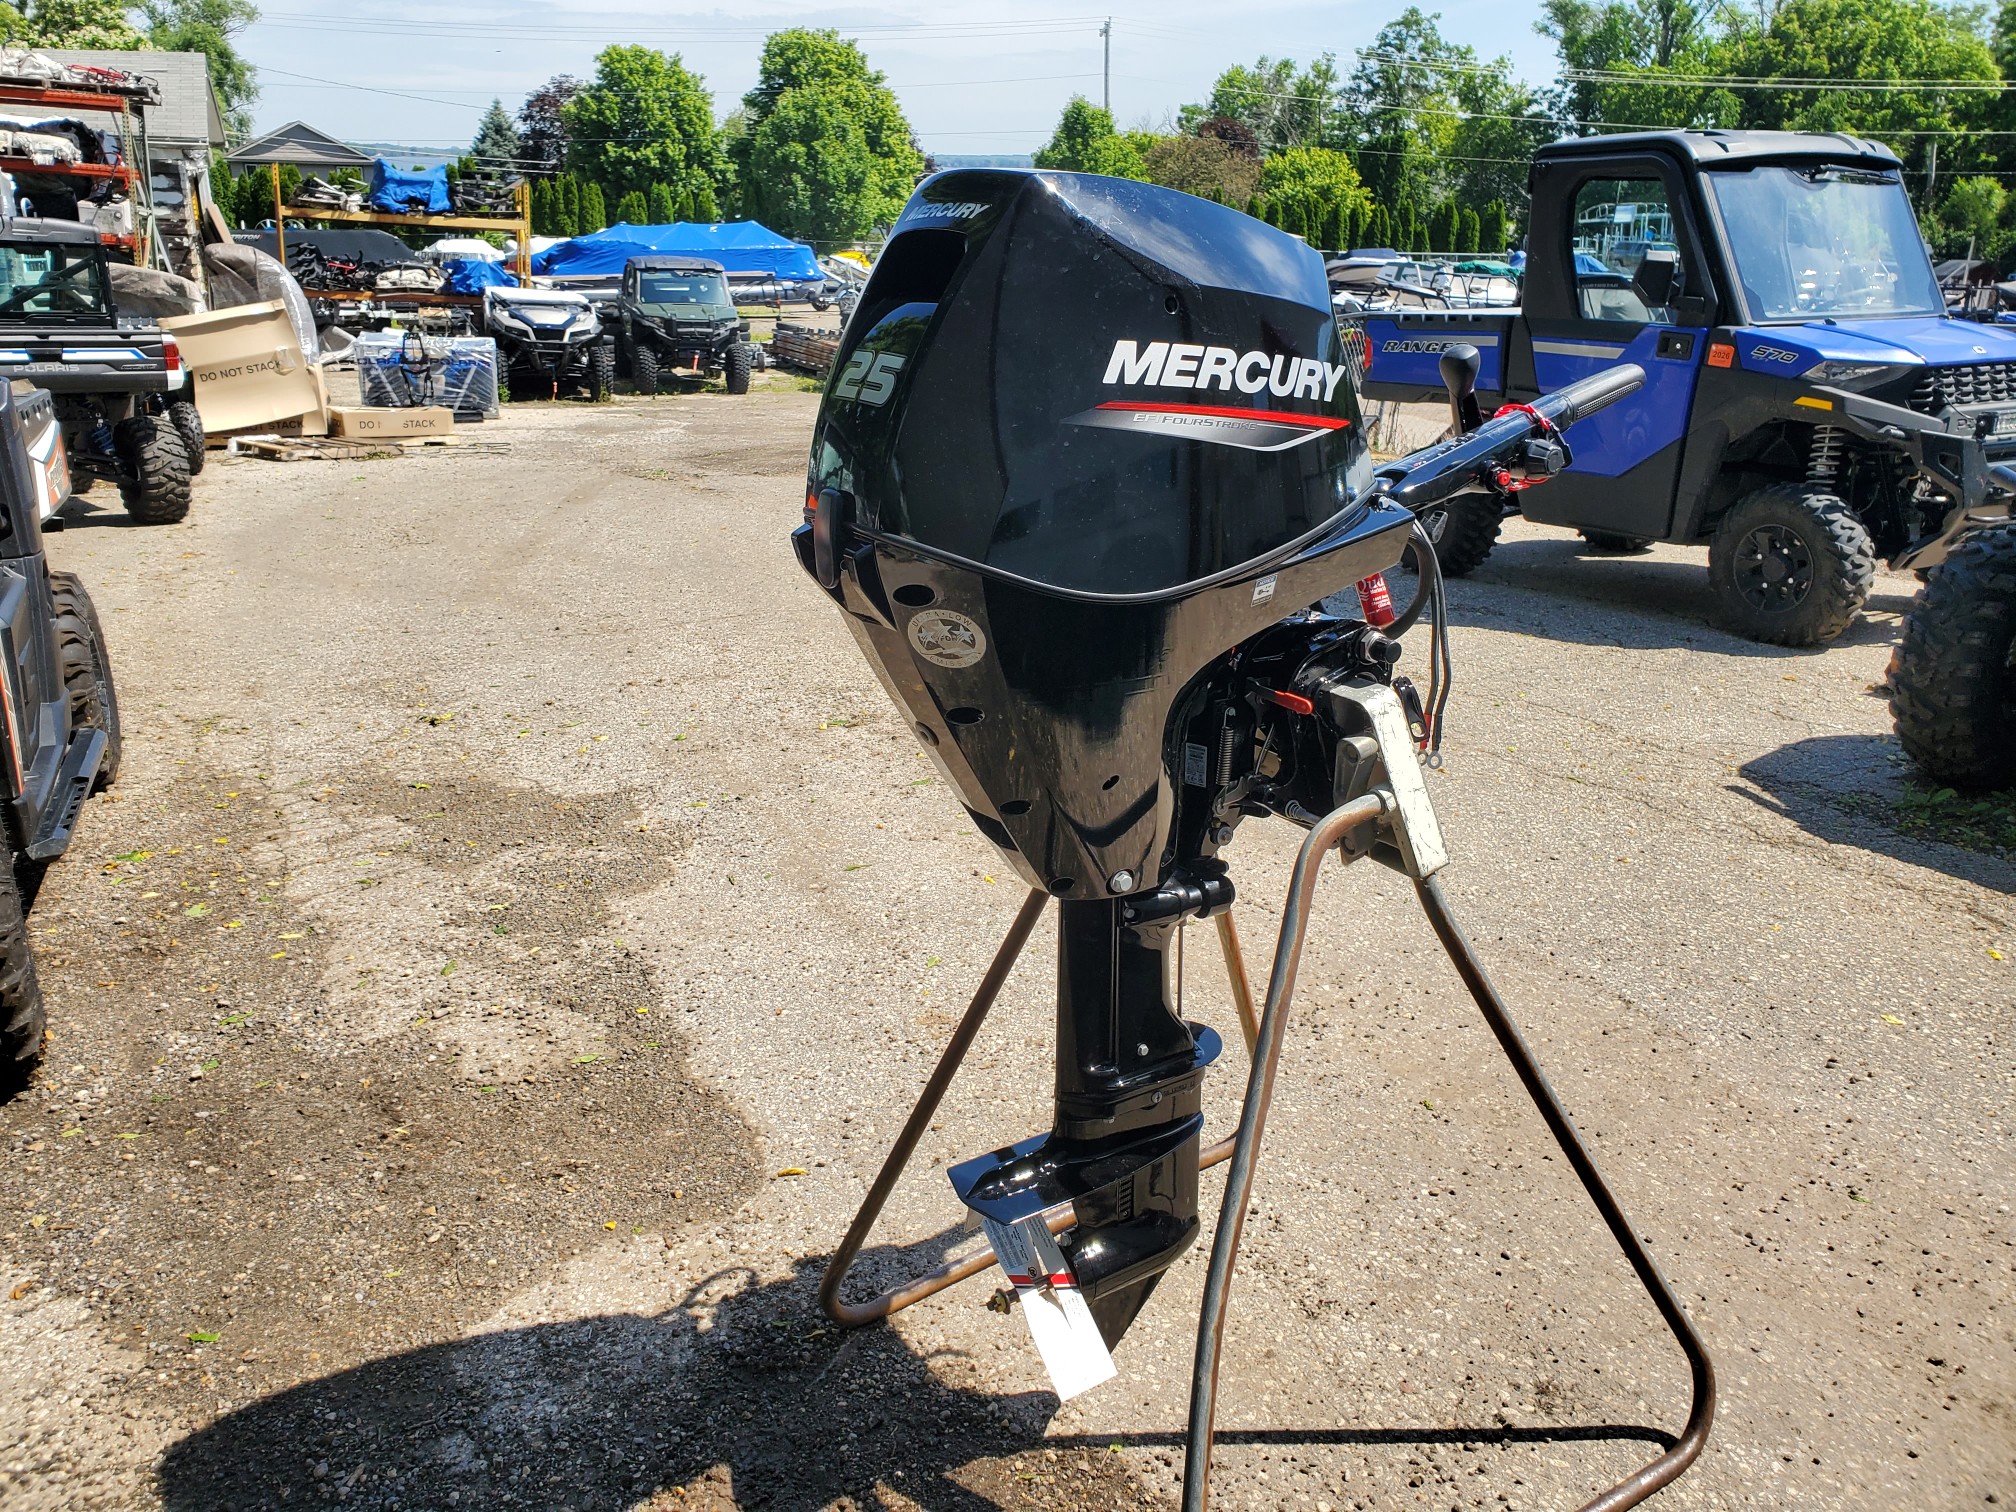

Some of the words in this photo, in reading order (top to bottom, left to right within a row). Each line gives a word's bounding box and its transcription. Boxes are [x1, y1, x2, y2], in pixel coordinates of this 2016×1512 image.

[905, 202, 990, 221] MERCURY
[1382, 340, 1469, 353] RANGE
[1712, 350, 1730, 360] 2026
[1750, 344, 1799, 364] 570
[13, 364, 80, 373] POLARIS
[199, 371, 217, 383] DO
[220, 366, 243, 379] NOT
[246, 360, 281, 374] STACK
[834, 347, 908, 407] 25
[1102, 339, 1346, 402] MERCURY
[268, 420, 303, 430] STACK
[359, 420, 375, 429] DO
[402, 420, 436, 429] STACK
[912, 610, 940, 628] ULRA
[948, 612, 973, 627] LOW
